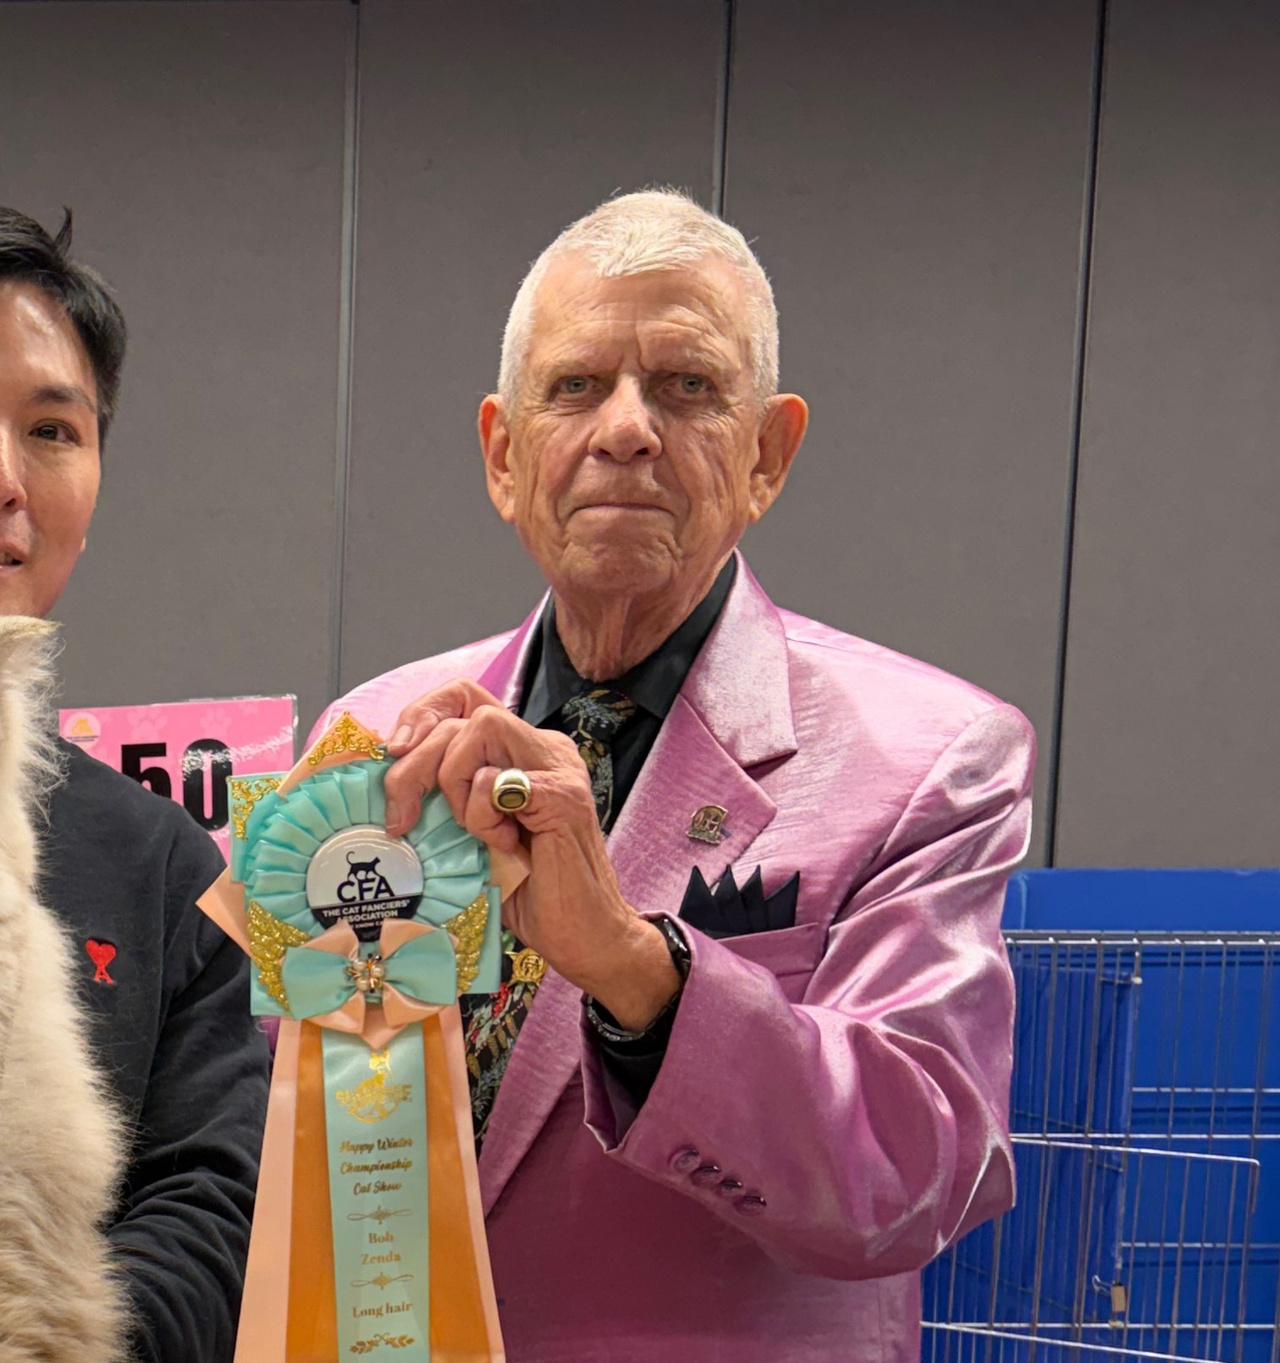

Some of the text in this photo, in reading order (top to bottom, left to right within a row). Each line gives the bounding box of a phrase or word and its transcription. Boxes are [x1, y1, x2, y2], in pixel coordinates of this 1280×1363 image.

[121, 738, 232, 832] 50
[337, 876, 396, 903] CFA
[322, 908, 340, 918] THE
[342, 906, 359, 915] CAT
[339, 1137, 413, 1155] Happy Winter
[340, 1157, 412, 1175] Championship
[353, 1180, 402, 1196] Cat Show
[368, 1230, 394, 1244] Bob
[361, 1250, 402, 1266] Zenda
[352, 1301, 413, 1318] Long hair
